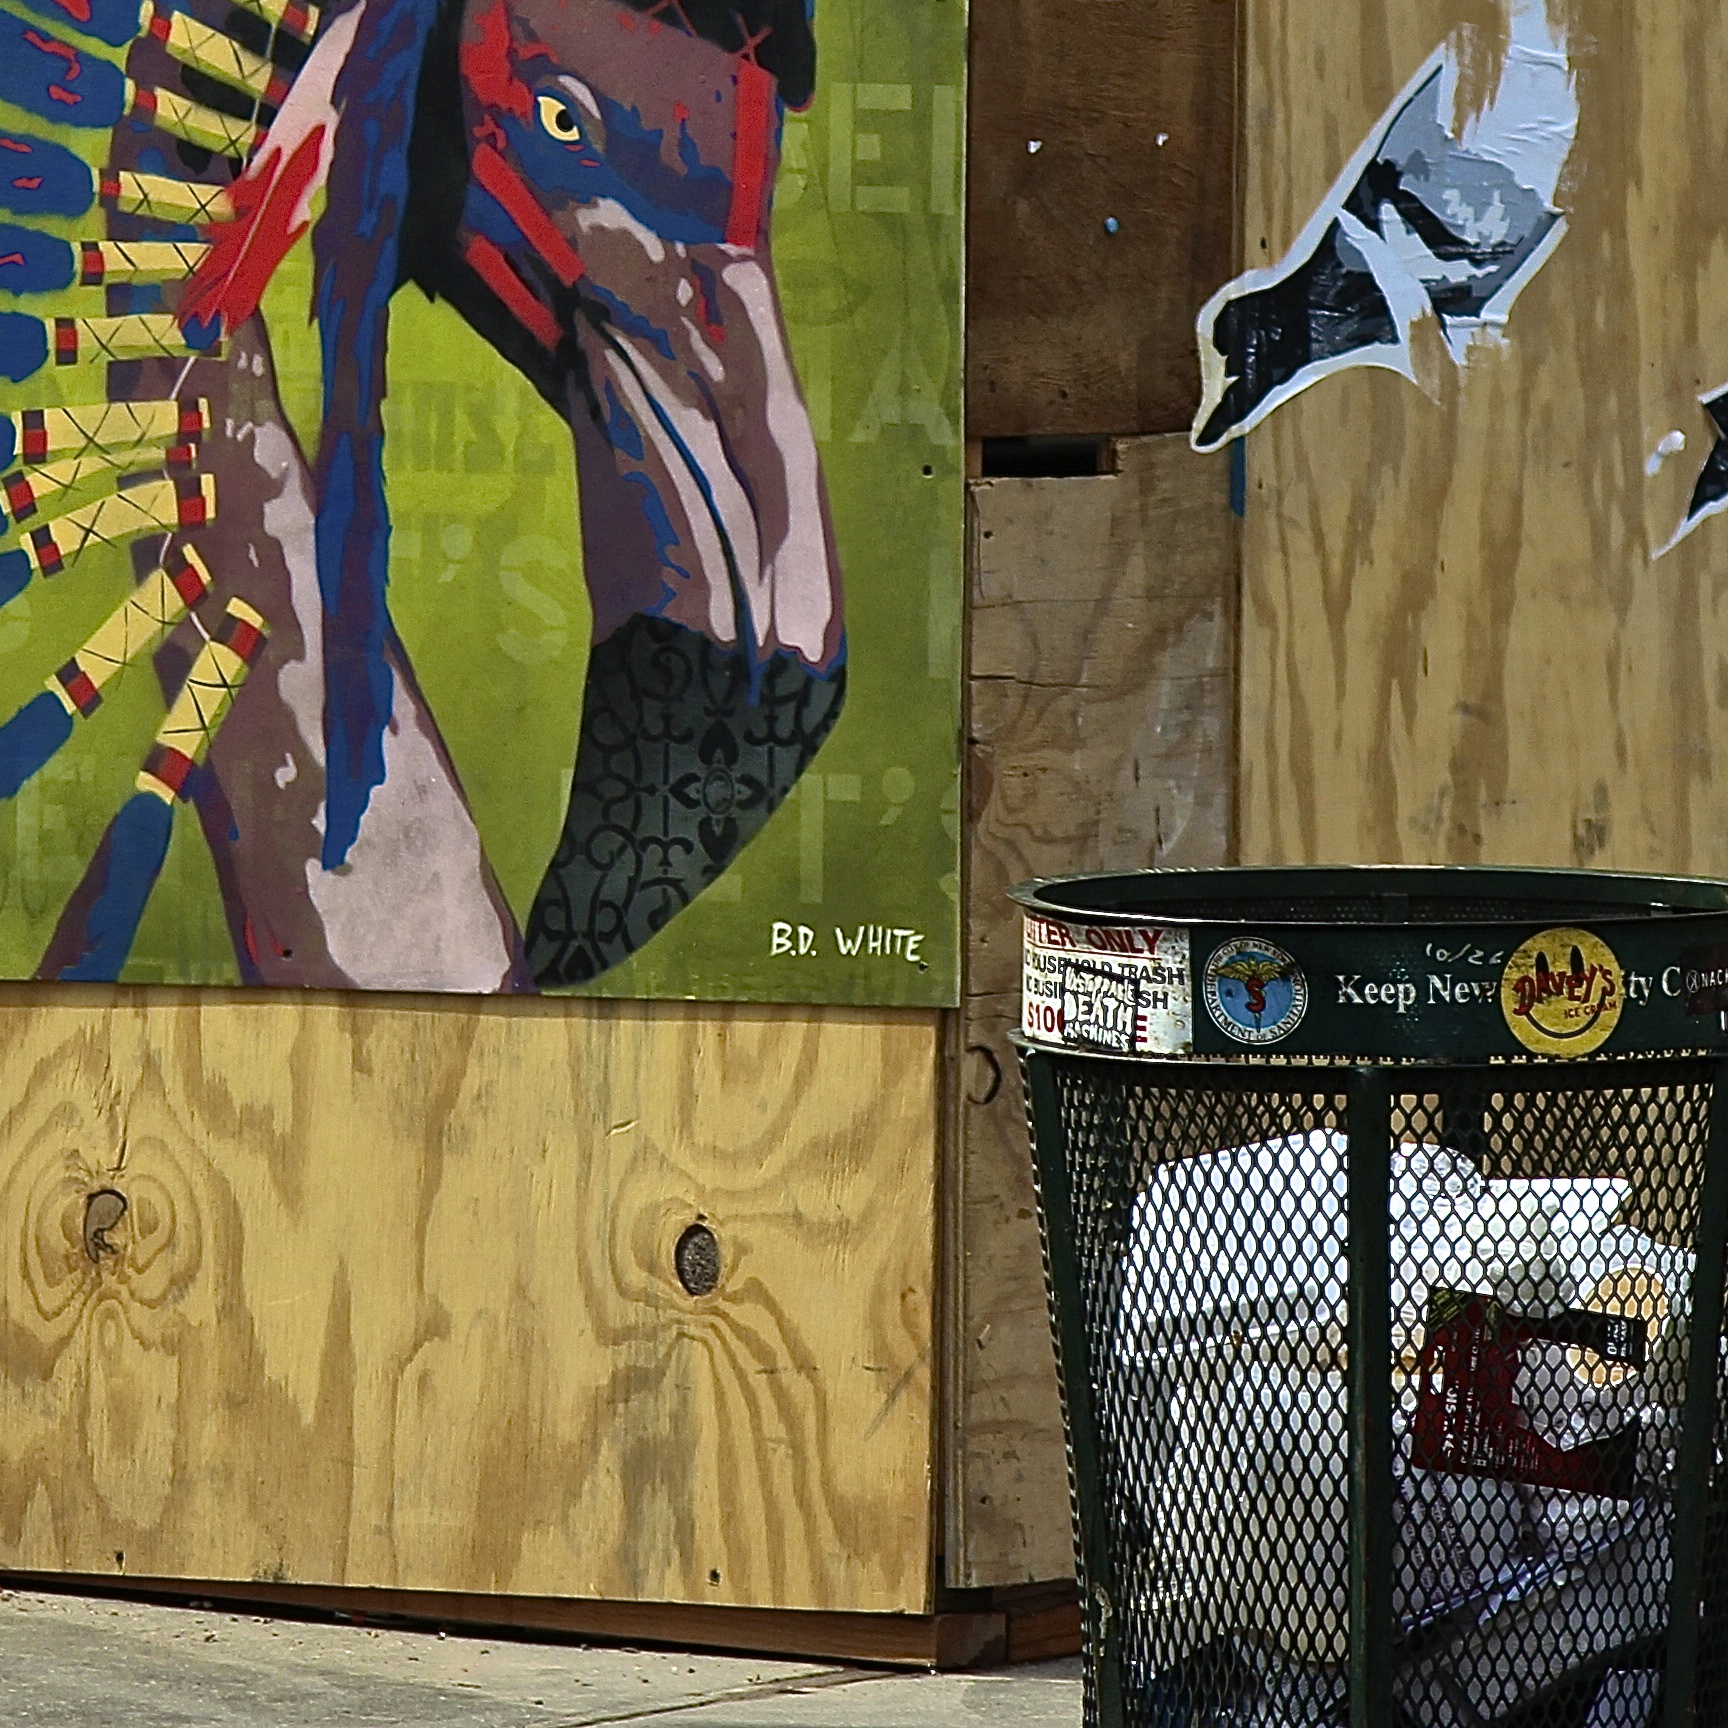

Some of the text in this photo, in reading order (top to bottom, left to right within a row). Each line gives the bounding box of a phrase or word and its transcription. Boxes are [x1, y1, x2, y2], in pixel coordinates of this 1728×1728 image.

[834, 923, 926, 963] WHITE
[1085, 927, 1165, 955] ONLY
[1119, 963, 1186, 986] TRASH
[1335, 971, 1416, 1014] Keep
[1426, 973, 1498, 1005] New
[1512, 963, 1617, 1016] DAVEY'S
[1063, 991, 1135, 1036] DEATH
[1563, 1008, 1582, 1020] ICE
